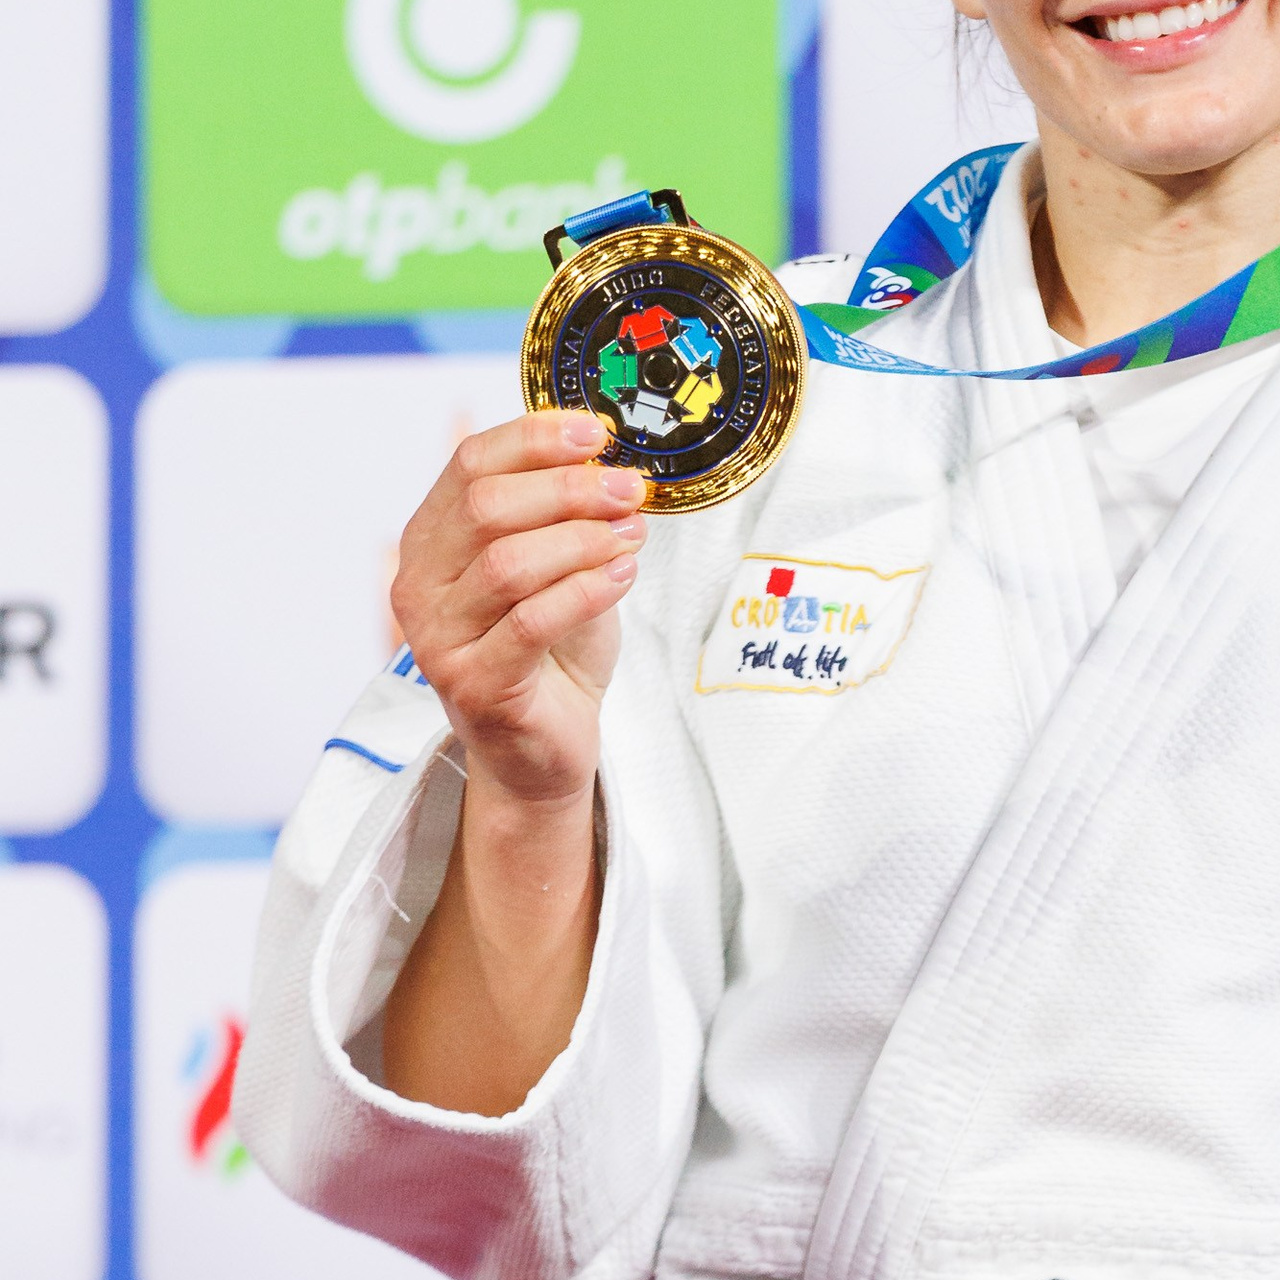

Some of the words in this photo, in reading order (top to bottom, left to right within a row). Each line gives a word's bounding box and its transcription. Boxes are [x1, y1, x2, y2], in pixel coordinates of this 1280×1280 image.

[602, 269, 664, 303] JUDO
[699, 281, 763, 433] FEDERATION
[731, 595, 872, 635] CROATIA
